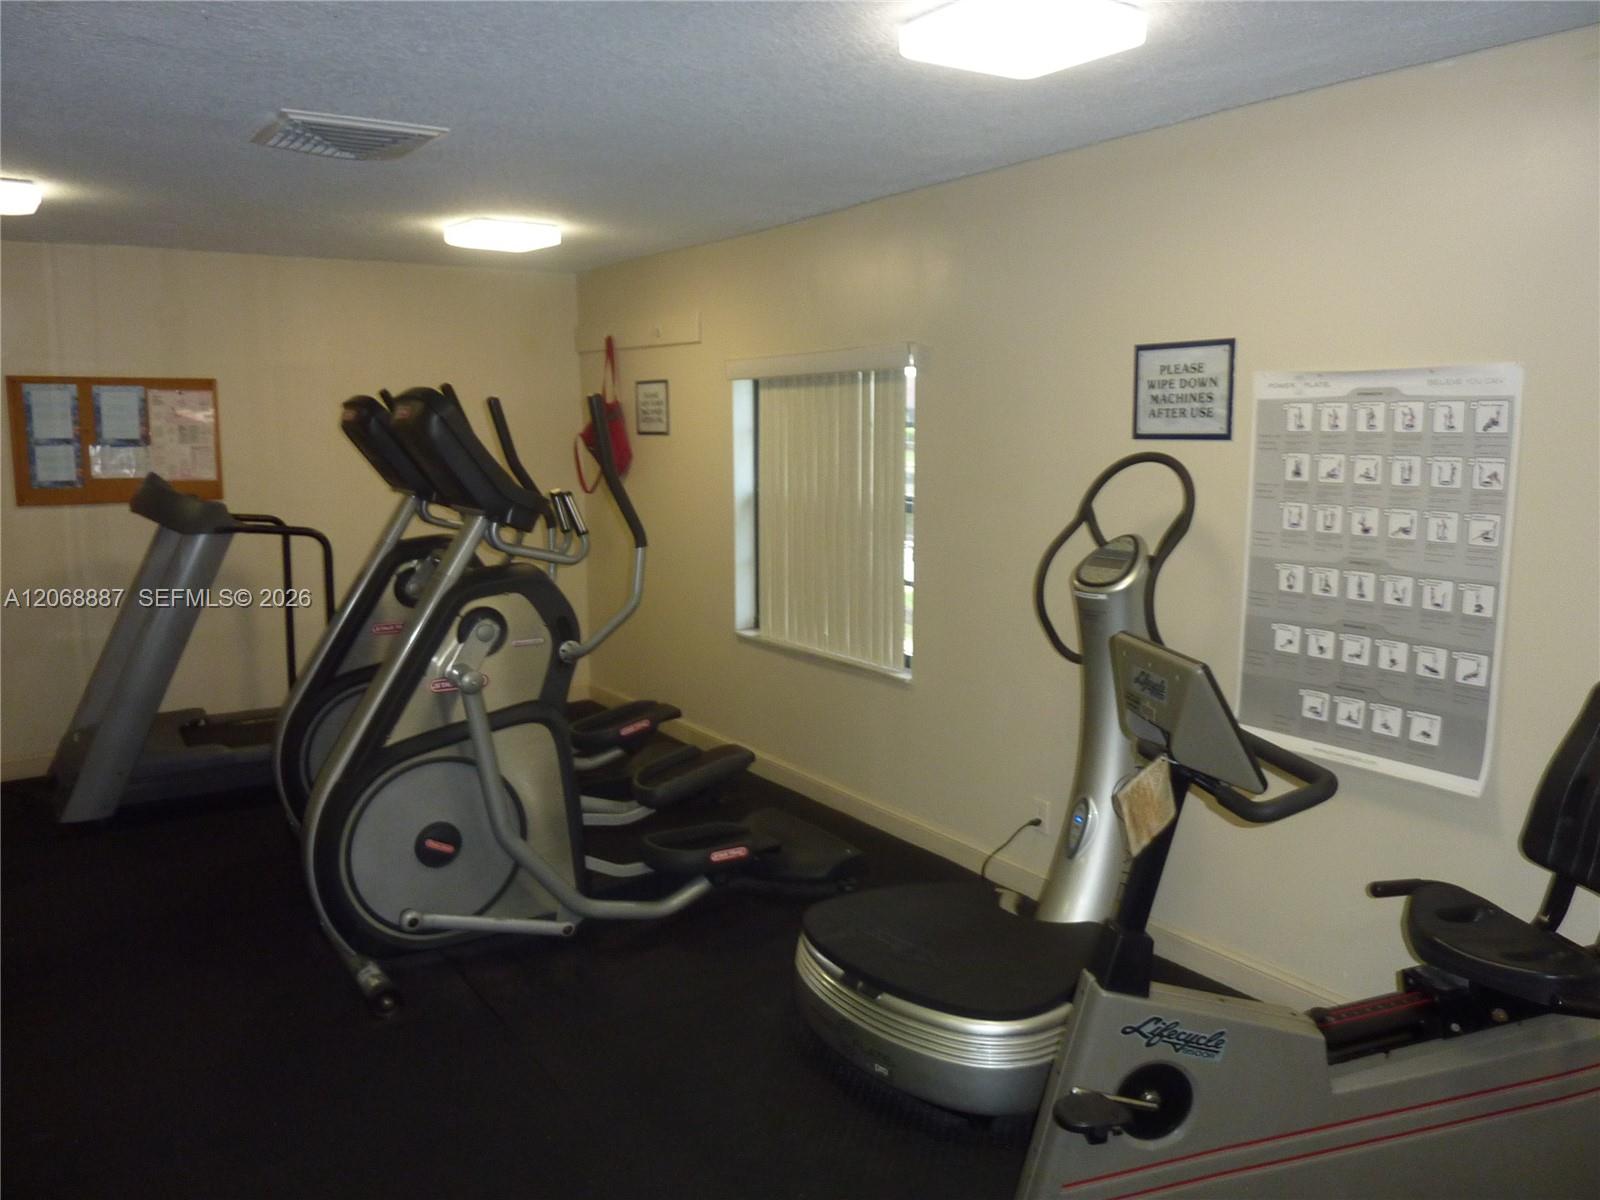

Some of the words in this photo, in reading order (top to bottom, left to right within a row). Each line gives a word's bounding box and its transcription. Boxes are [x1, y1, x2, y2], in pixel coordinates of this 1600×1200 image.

[1159, 362, 1204, 375] PLEASE
[1147, 378, 1176, 390] WIPE
[1179, 376, 1218, 389] DOWN
[1150, 392, 1214, 404] MACHINES
[1148, 407, 1186, 419] AFTER
[1190, 406, 1214, 418] USE
[1121, 1017, 1225, 1052] Lifecycle
